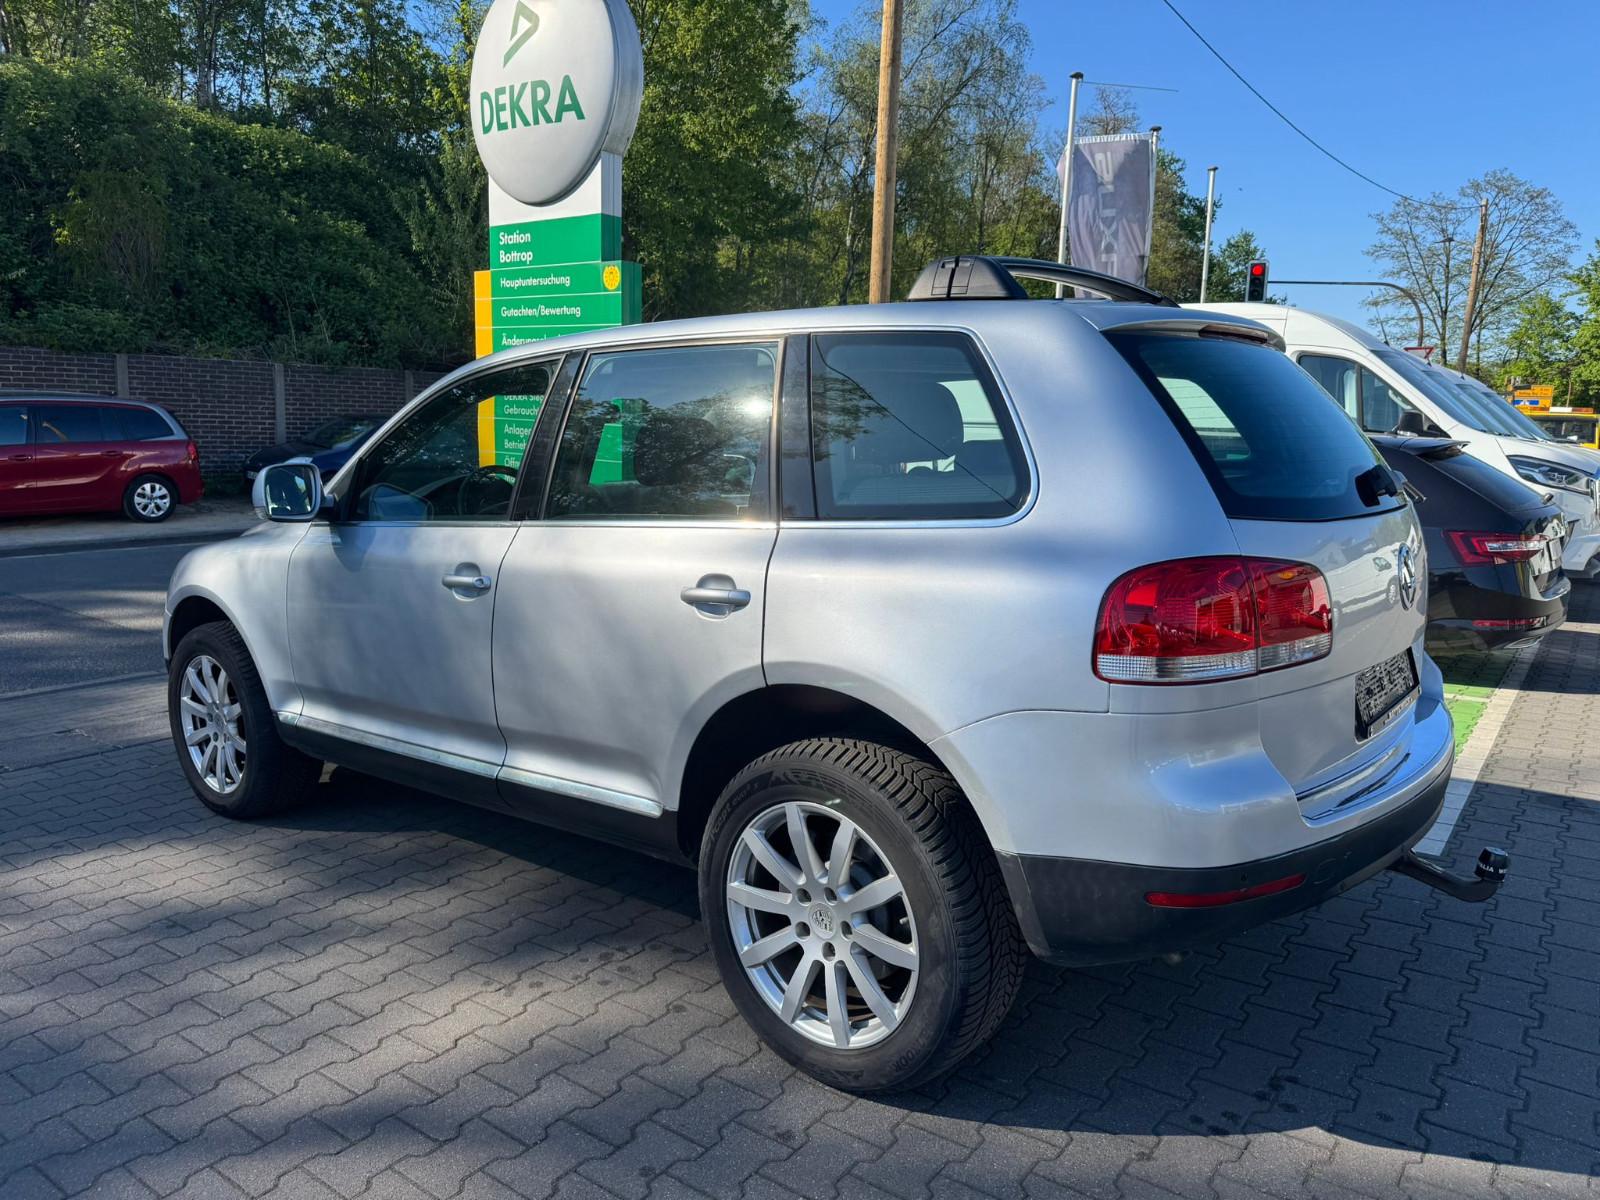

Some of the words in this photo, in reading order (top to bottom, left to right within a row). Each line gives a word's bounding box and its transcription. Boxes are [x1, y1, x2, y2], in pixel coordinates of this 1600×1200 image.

[480, 74, 586, 135] DEKRA
[499, 230, 531, 245] Station
[499, 250, 533, 264] Bottrop
[500, 273, 570, 289] Hauptuntersuchung
[501, 304, 581, 318] Gutachten/Bewertung
[504, 404, 539, 415] Gebrauch
